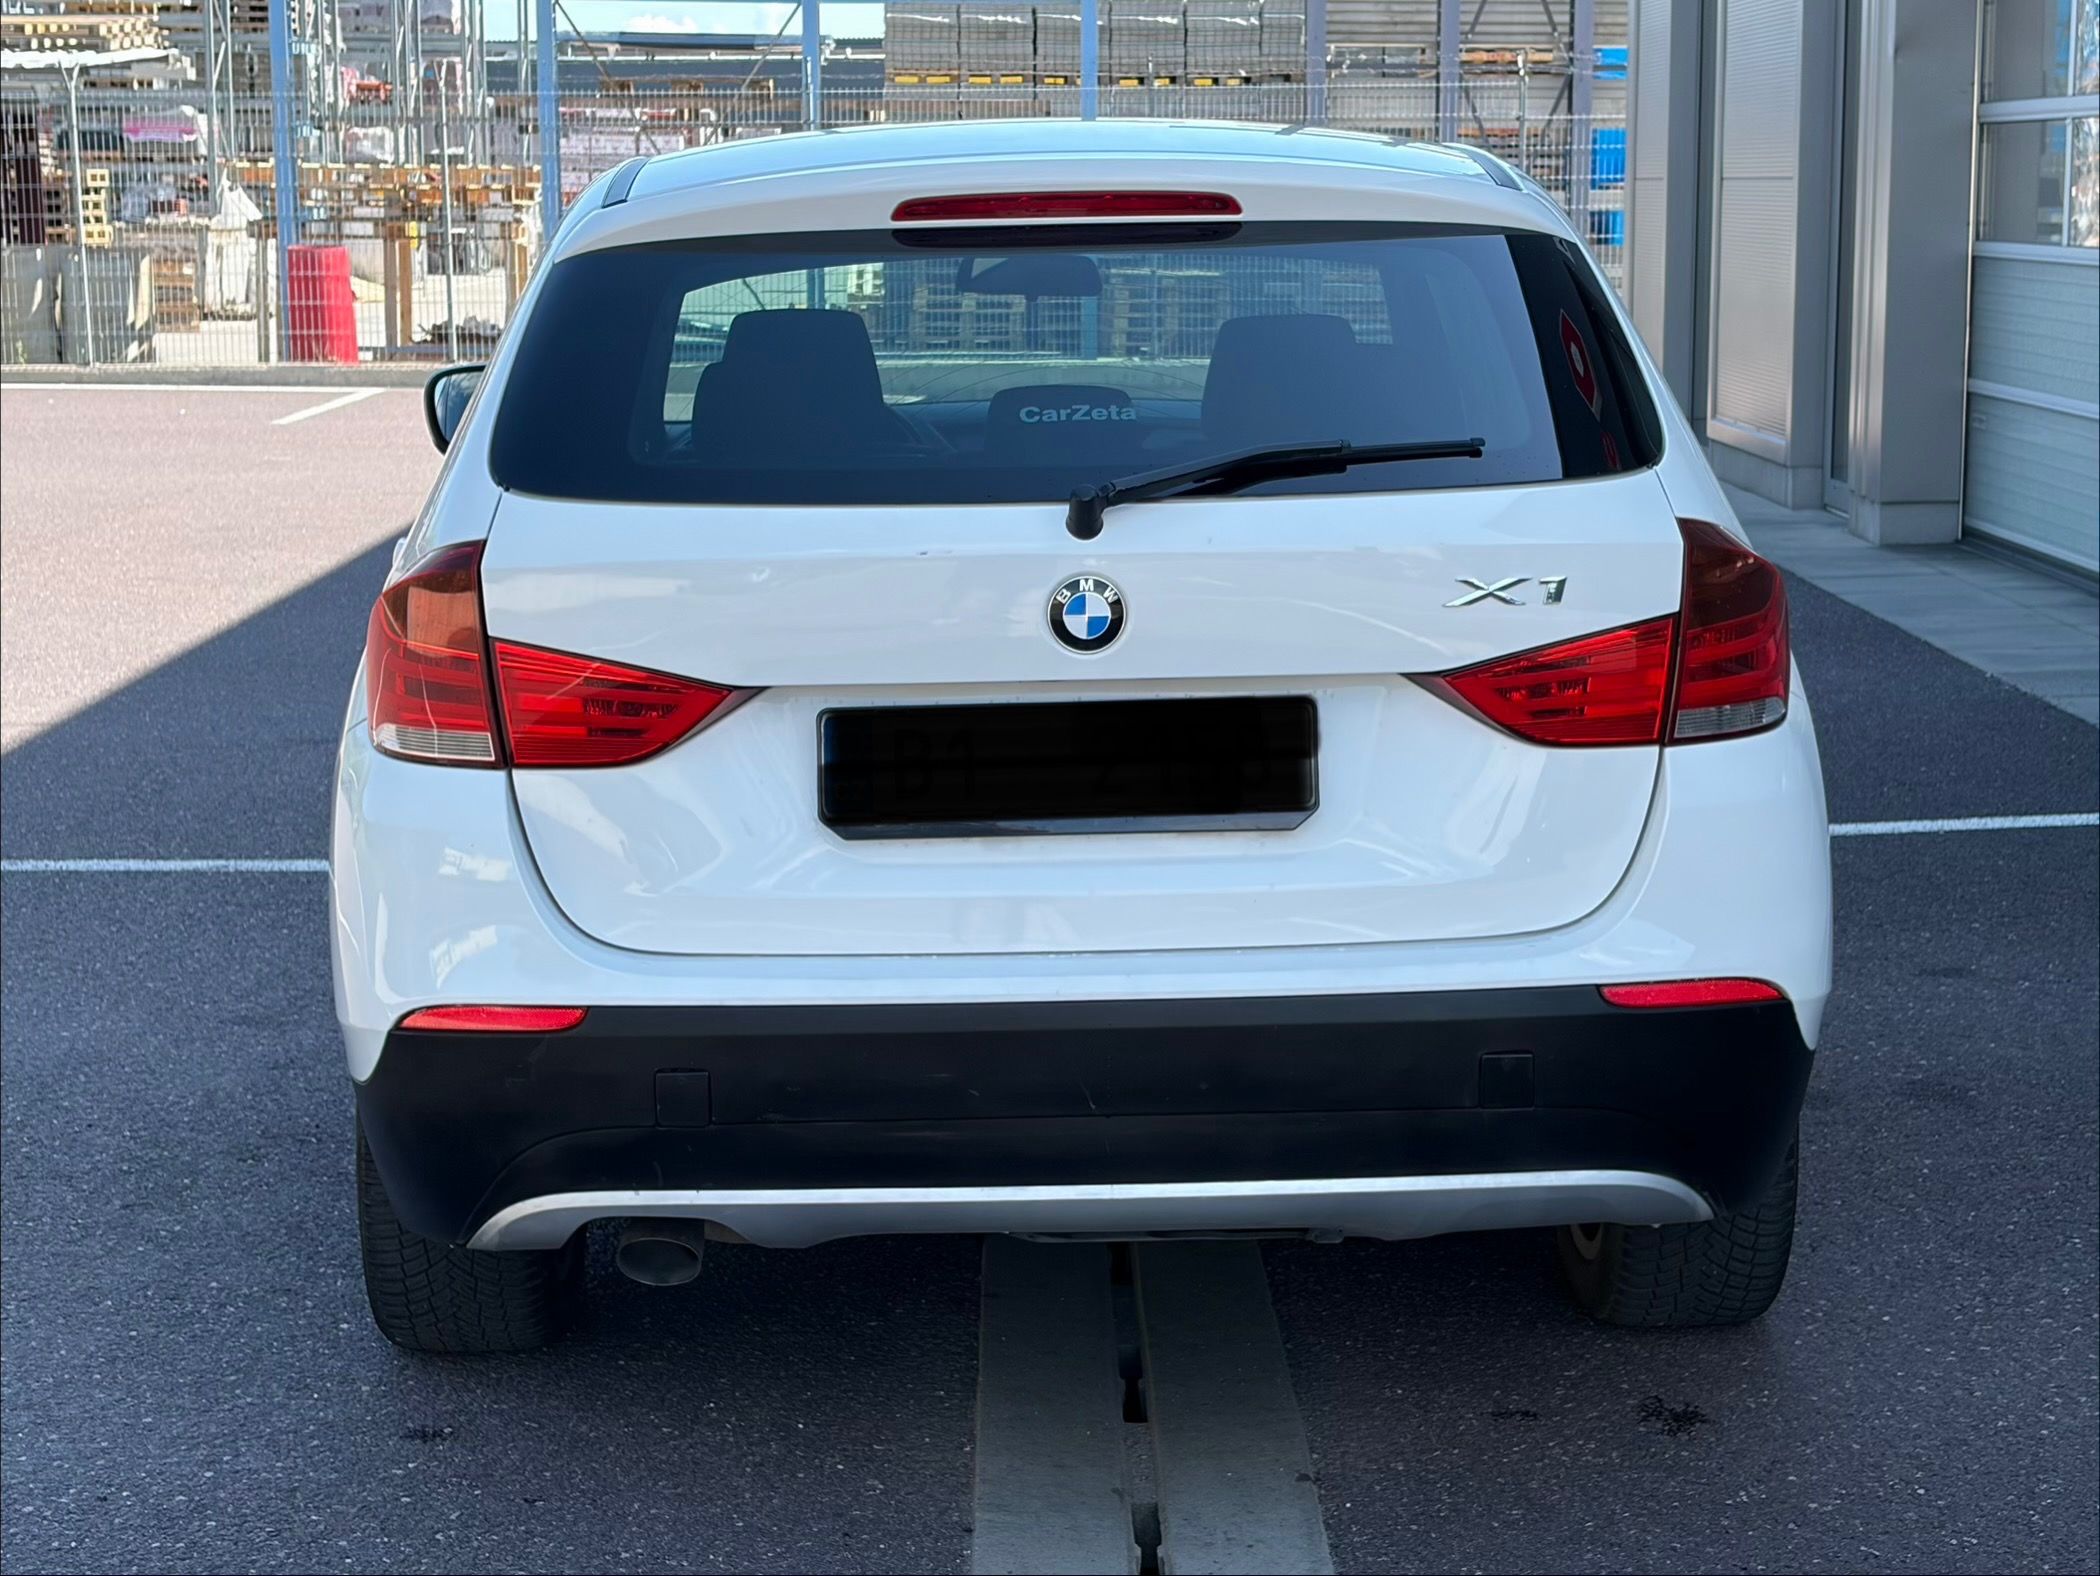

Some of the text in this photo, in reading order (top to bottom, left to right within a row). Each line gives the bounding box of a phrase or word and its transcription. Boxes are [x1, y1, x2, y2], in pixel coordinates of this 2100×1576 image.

[1020, 405, 1137, 423] CarZeta
[1056, 578, 1119, 604] BMW
[1442, 576, 1567, 607] X1
